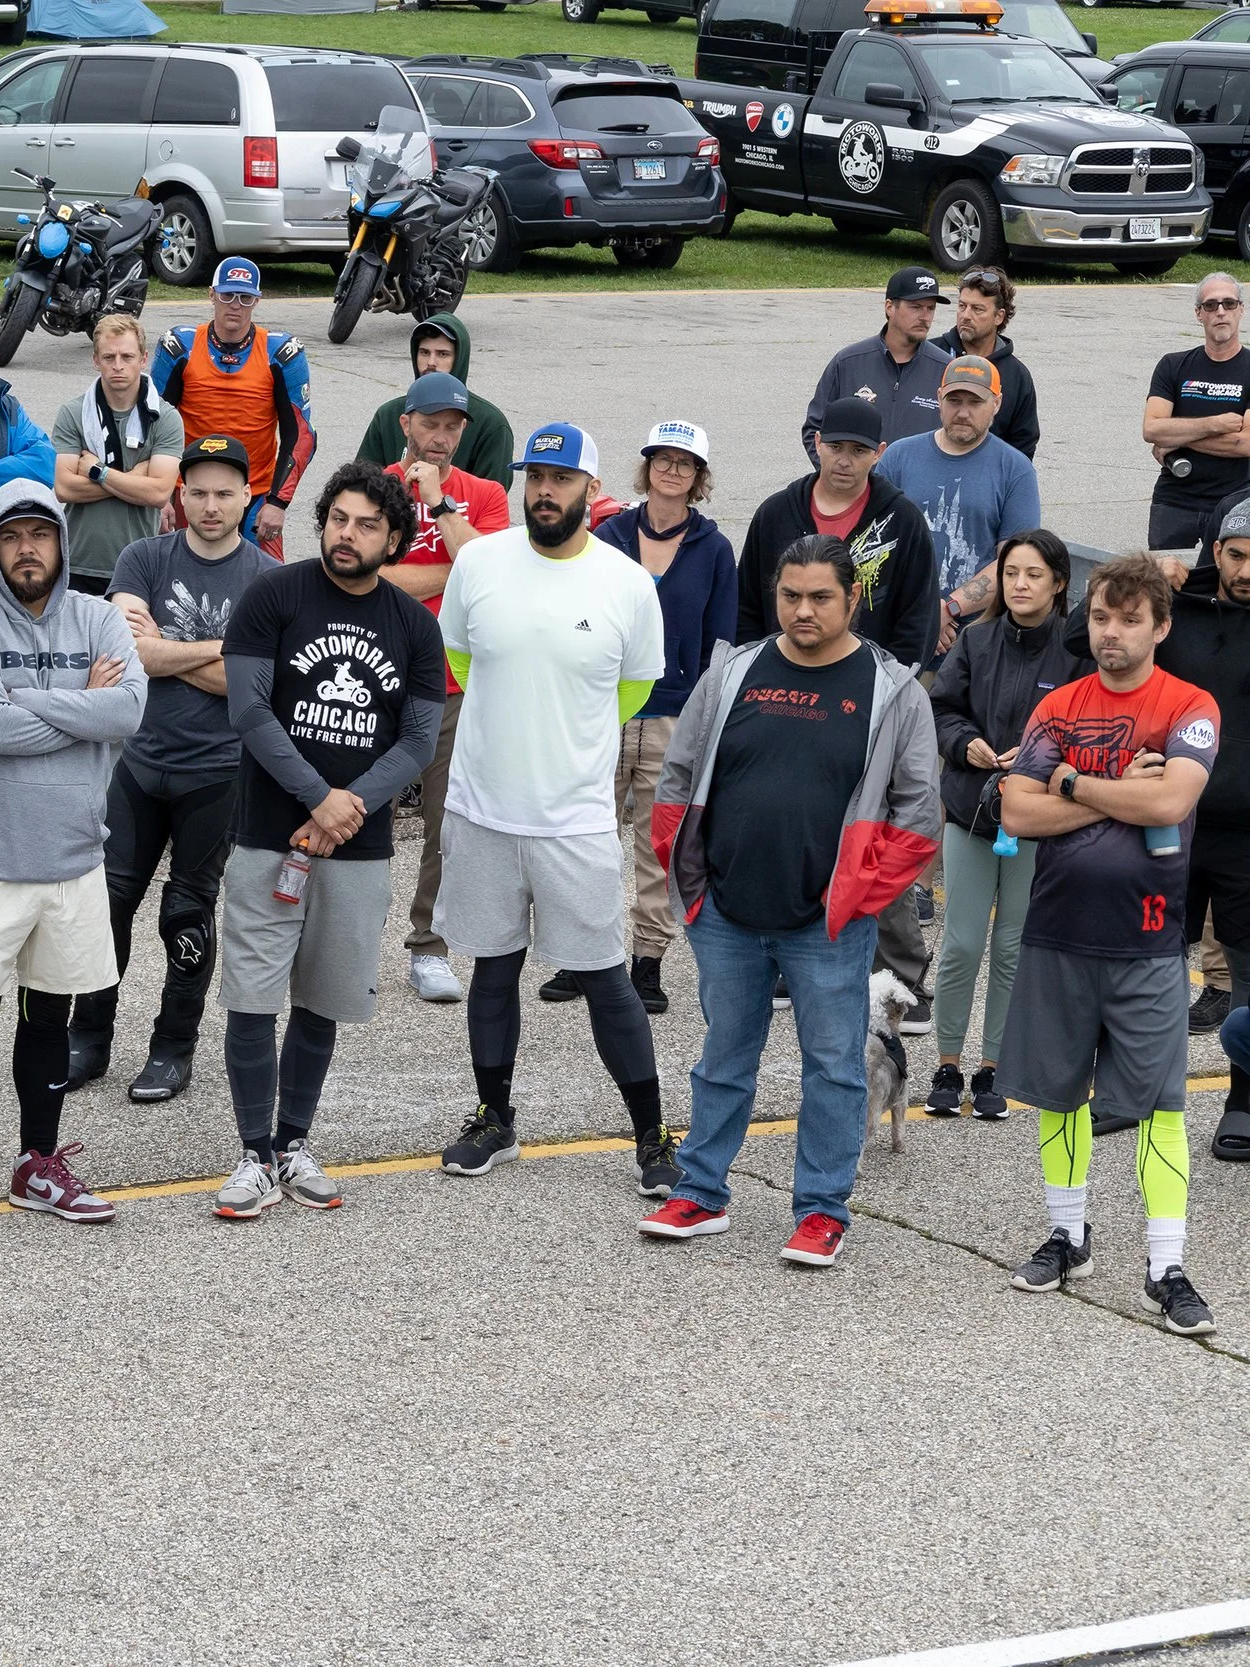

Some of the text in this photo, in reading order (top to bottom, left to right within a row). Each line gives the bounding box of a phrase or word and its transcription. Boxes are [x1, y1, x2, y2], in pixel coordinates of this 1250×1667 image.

[702, 101, 737, 118] TRIUMPH
[757, 146, 778, 155] WESTERN
[841, 124, 882, 162] MOTOWORKS
[892, 147, 915, 156] RAM
[926, 137, 937, 149] 312
[892, 154, 914, 162] 1500
[848, 178, 874, 190] CHICAGO
[1189, 381, 1243, 391] MOTOWORKS
[659, 427, 694, 438] YAMAHA
[327, 623, 378, 640] PROPERTY OF
[0, 651, 90, 670] BEARS
[289, 634, 400, 692] MOTOWORKS
[744, 688, 820, 706] DUCATI
[293, 701, 378, 734] CHICAGO
[759, 702, 828, 721] CHICAGO
[290, 725, 374, 748] LIVE FREE OR DIE
[1142, 895, 1166, 931] 13
